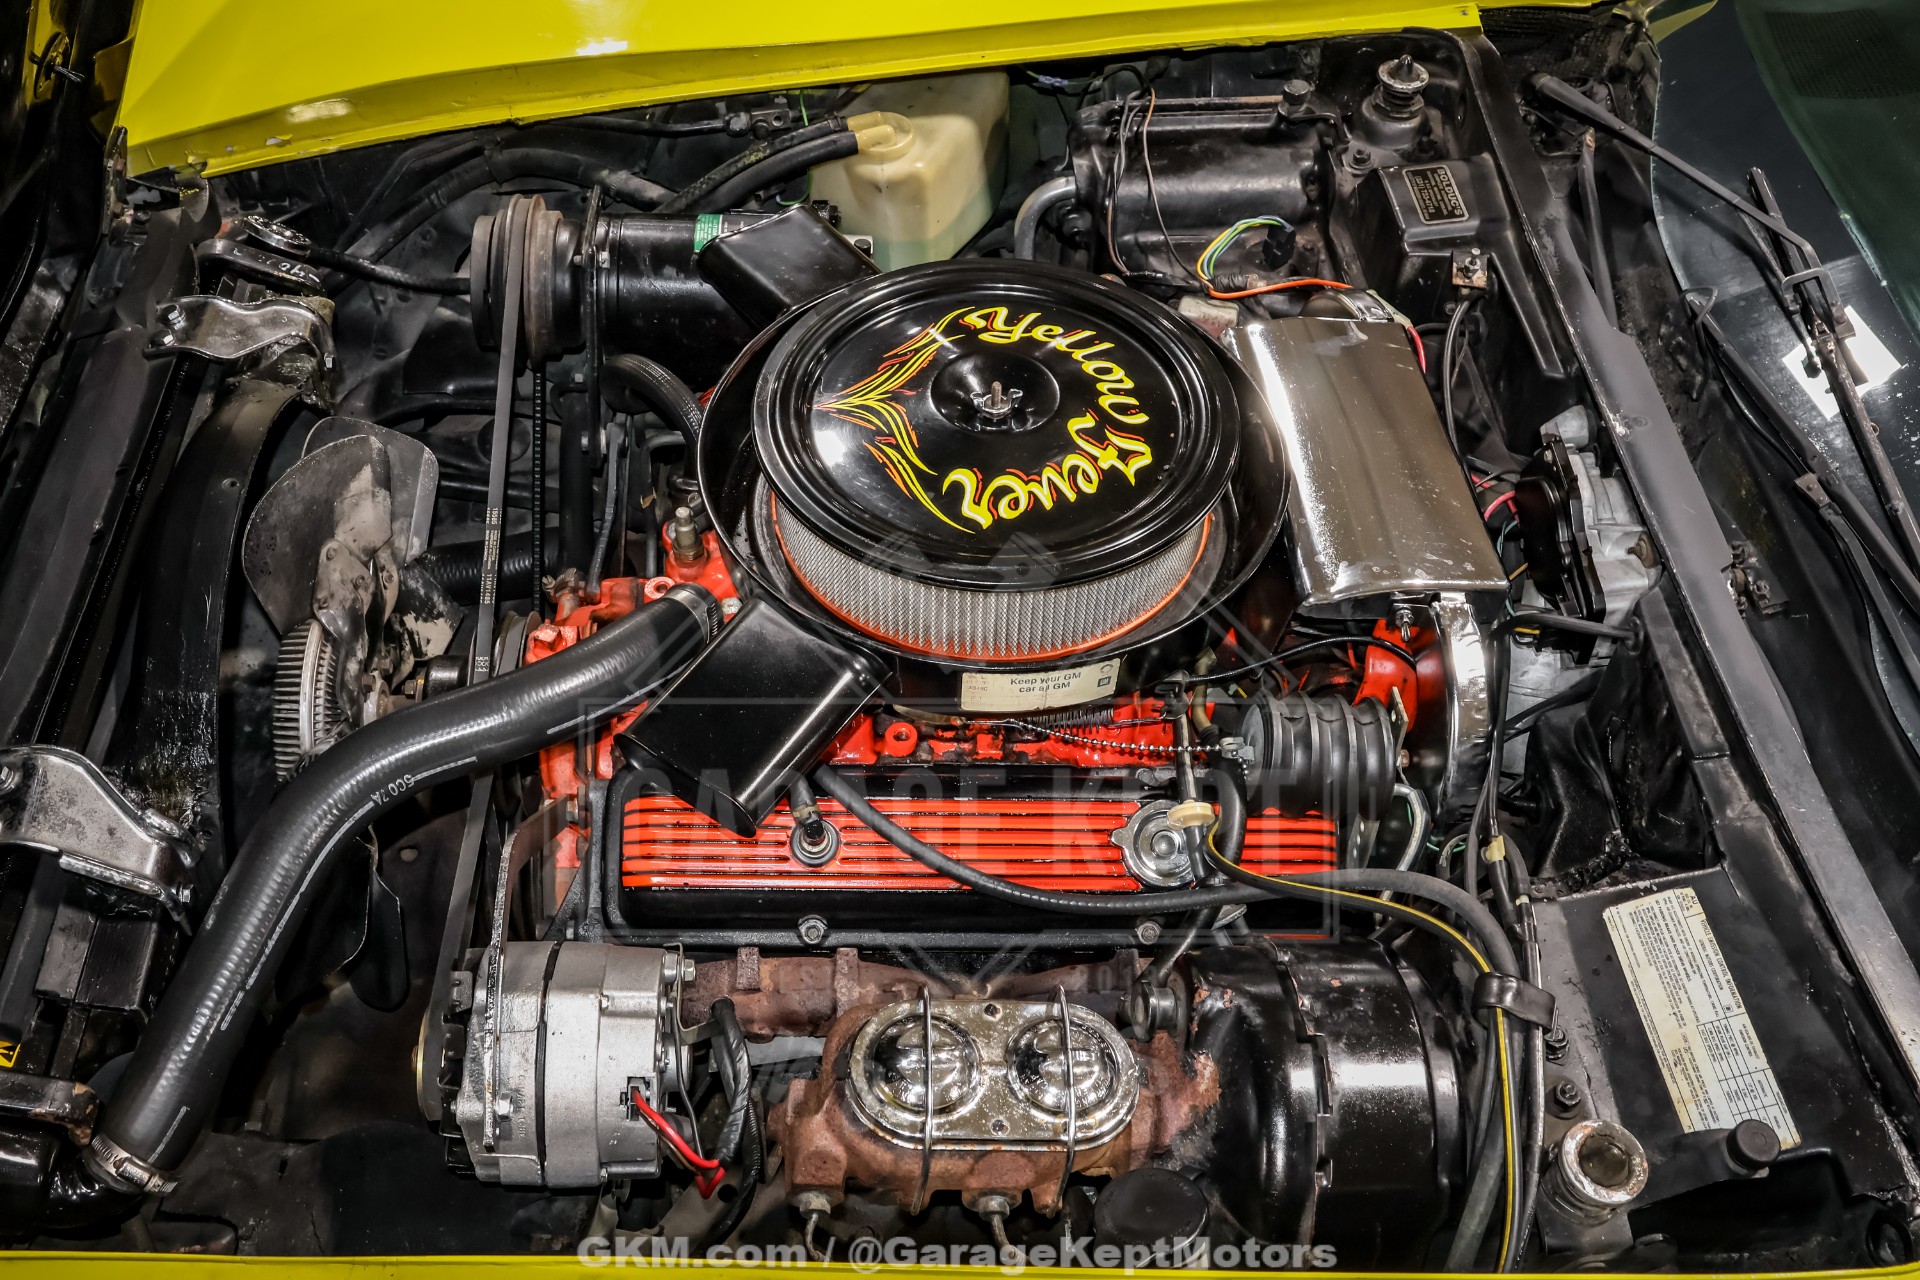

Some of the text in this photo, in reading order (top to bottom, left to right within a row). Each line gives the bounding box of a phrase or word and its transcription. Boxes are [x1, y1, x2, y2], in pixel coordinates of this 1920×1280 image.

[1436, 168, 1462, 215] BOLDUC'S
[943, 307, 1152, 529] Yellow Fever
[1010, 678, 1037, 687] Keep
[1063, 672, 1081, 680] GM
[1019, 685, 1036, 693] car
[1053, 682, 1071, 690] GM
